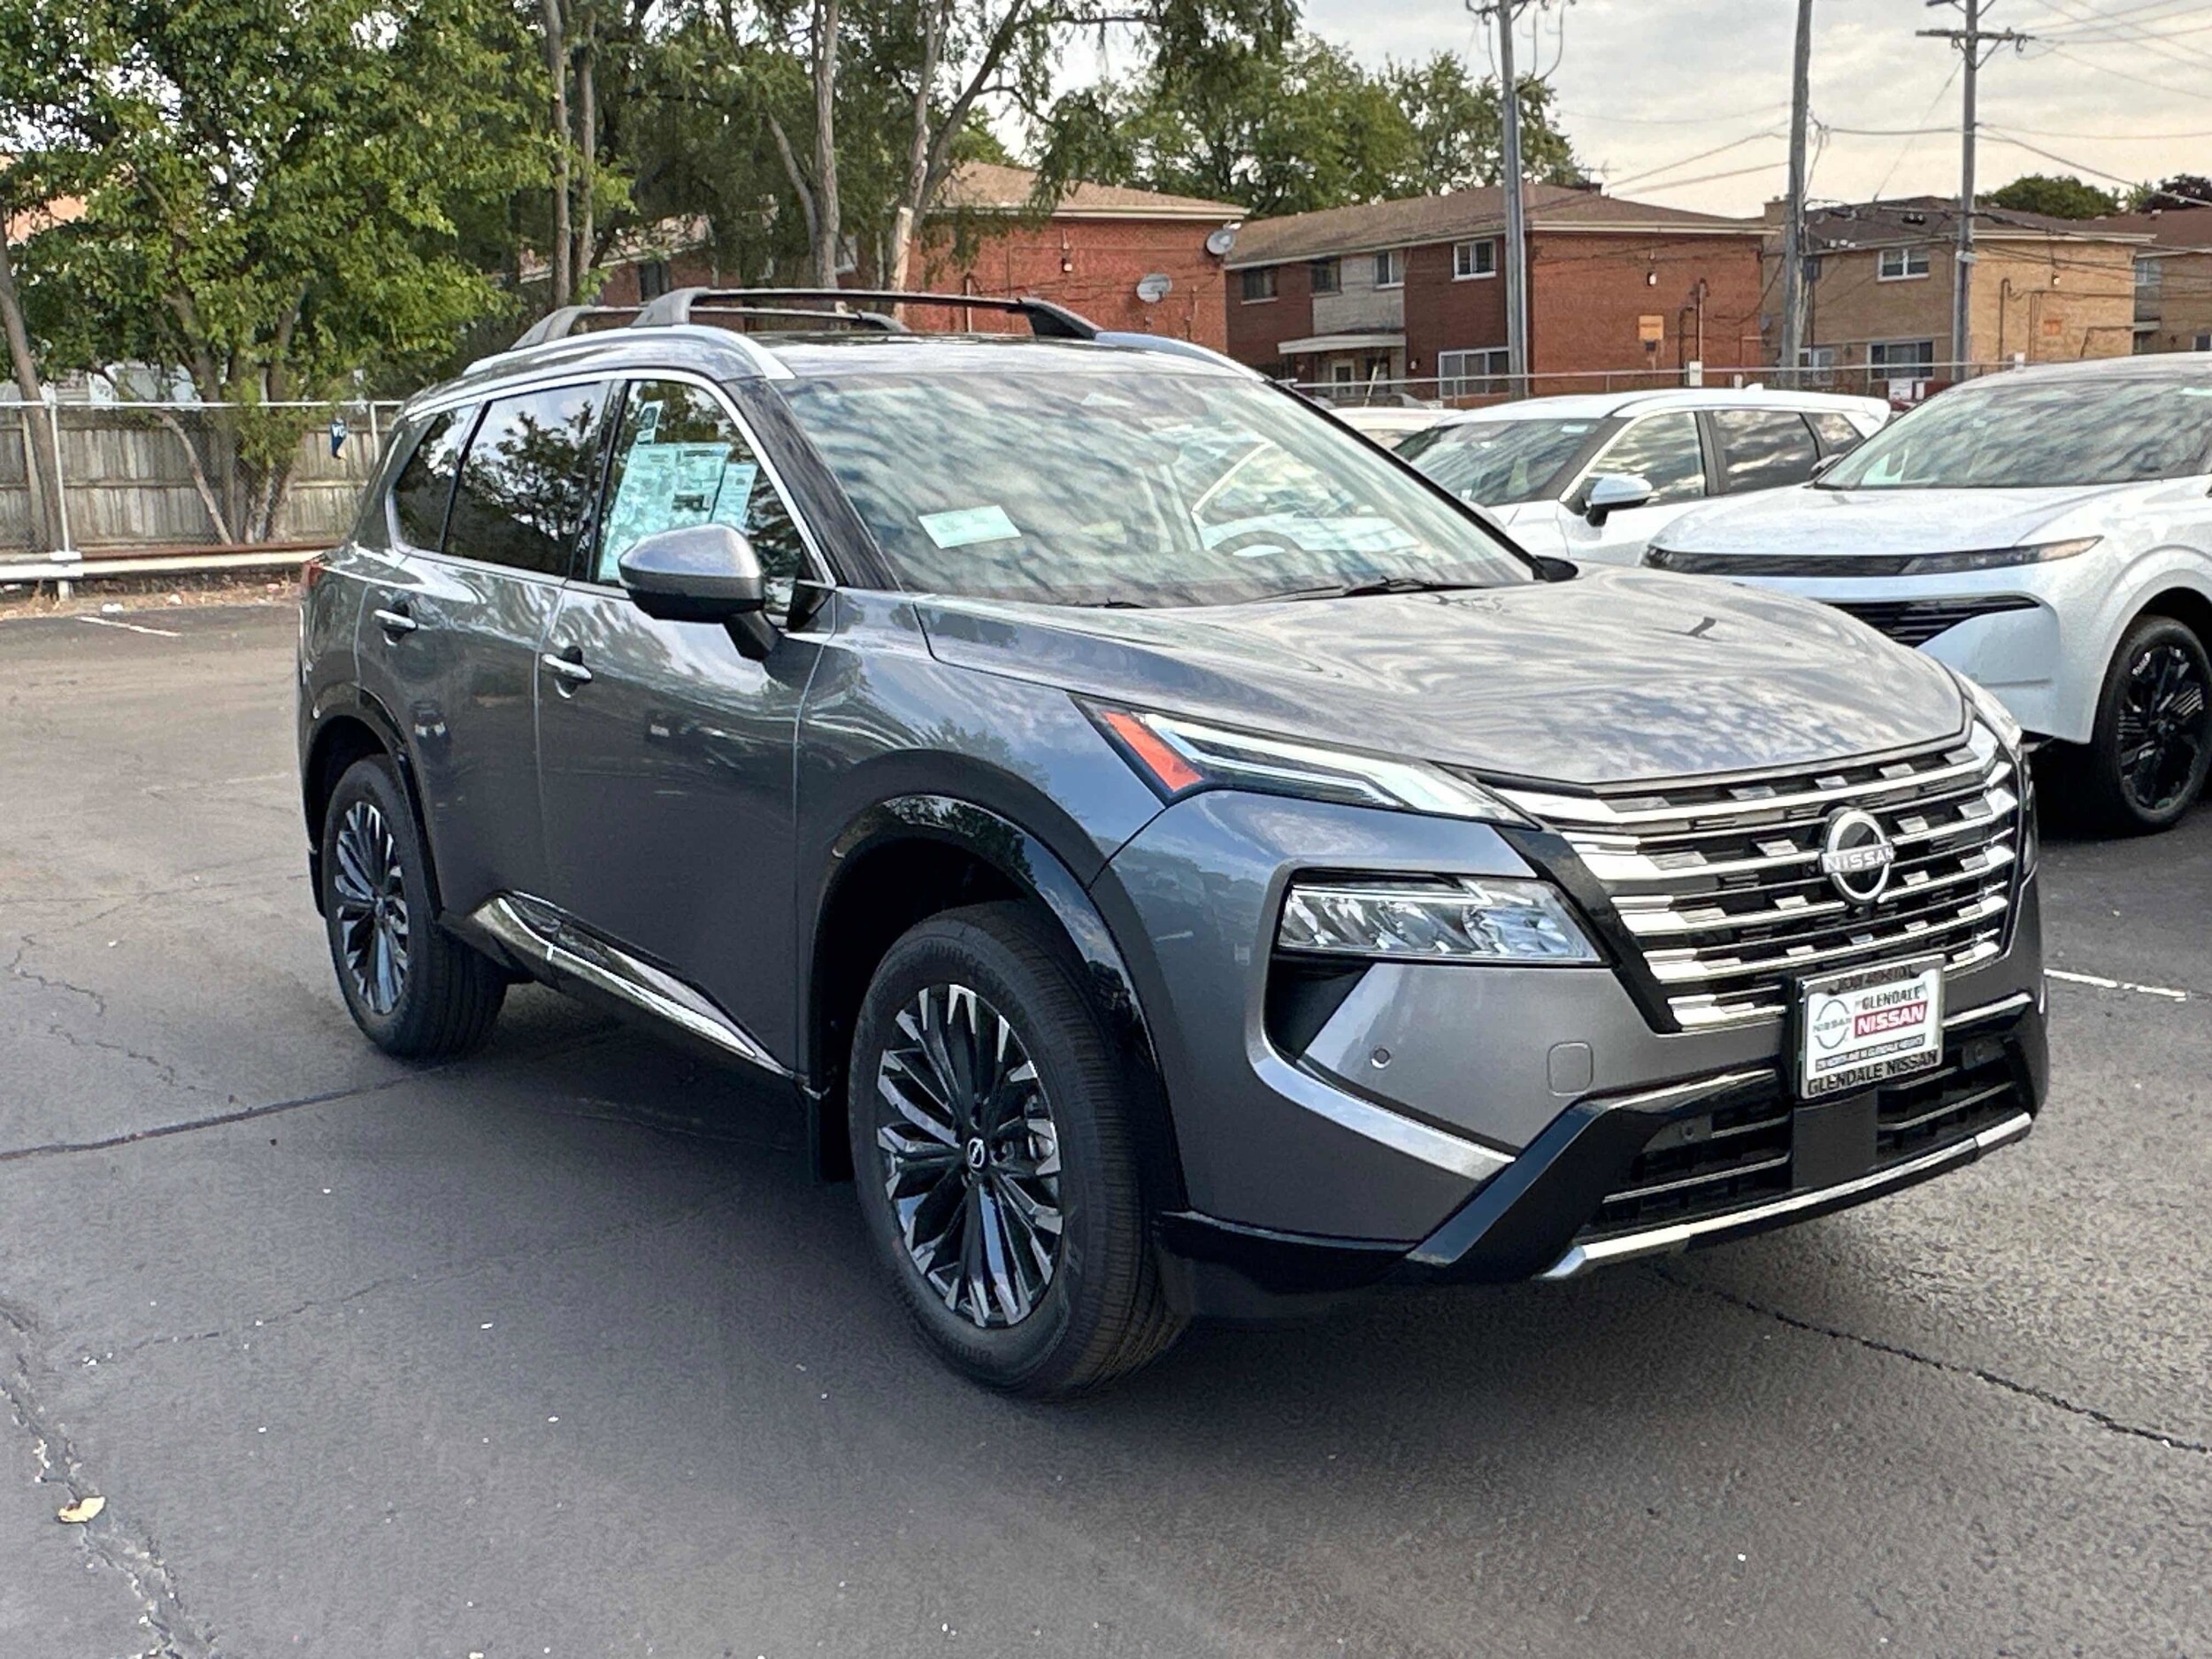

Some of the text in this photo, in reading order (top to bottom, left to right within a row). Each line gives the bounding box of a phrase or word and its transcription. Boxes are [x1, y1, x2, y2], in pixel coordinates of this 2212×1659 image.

[1823, 847, 1894, 873] NISSAN
[1863, 986, 1920, 1010] GLENDALE
[1858, 1004, 1924, 1034] NISSAN
[1808, 1062, 1883, 1095] GLENDALE
[1886, 1049, 1938, 1075] NISSAN
